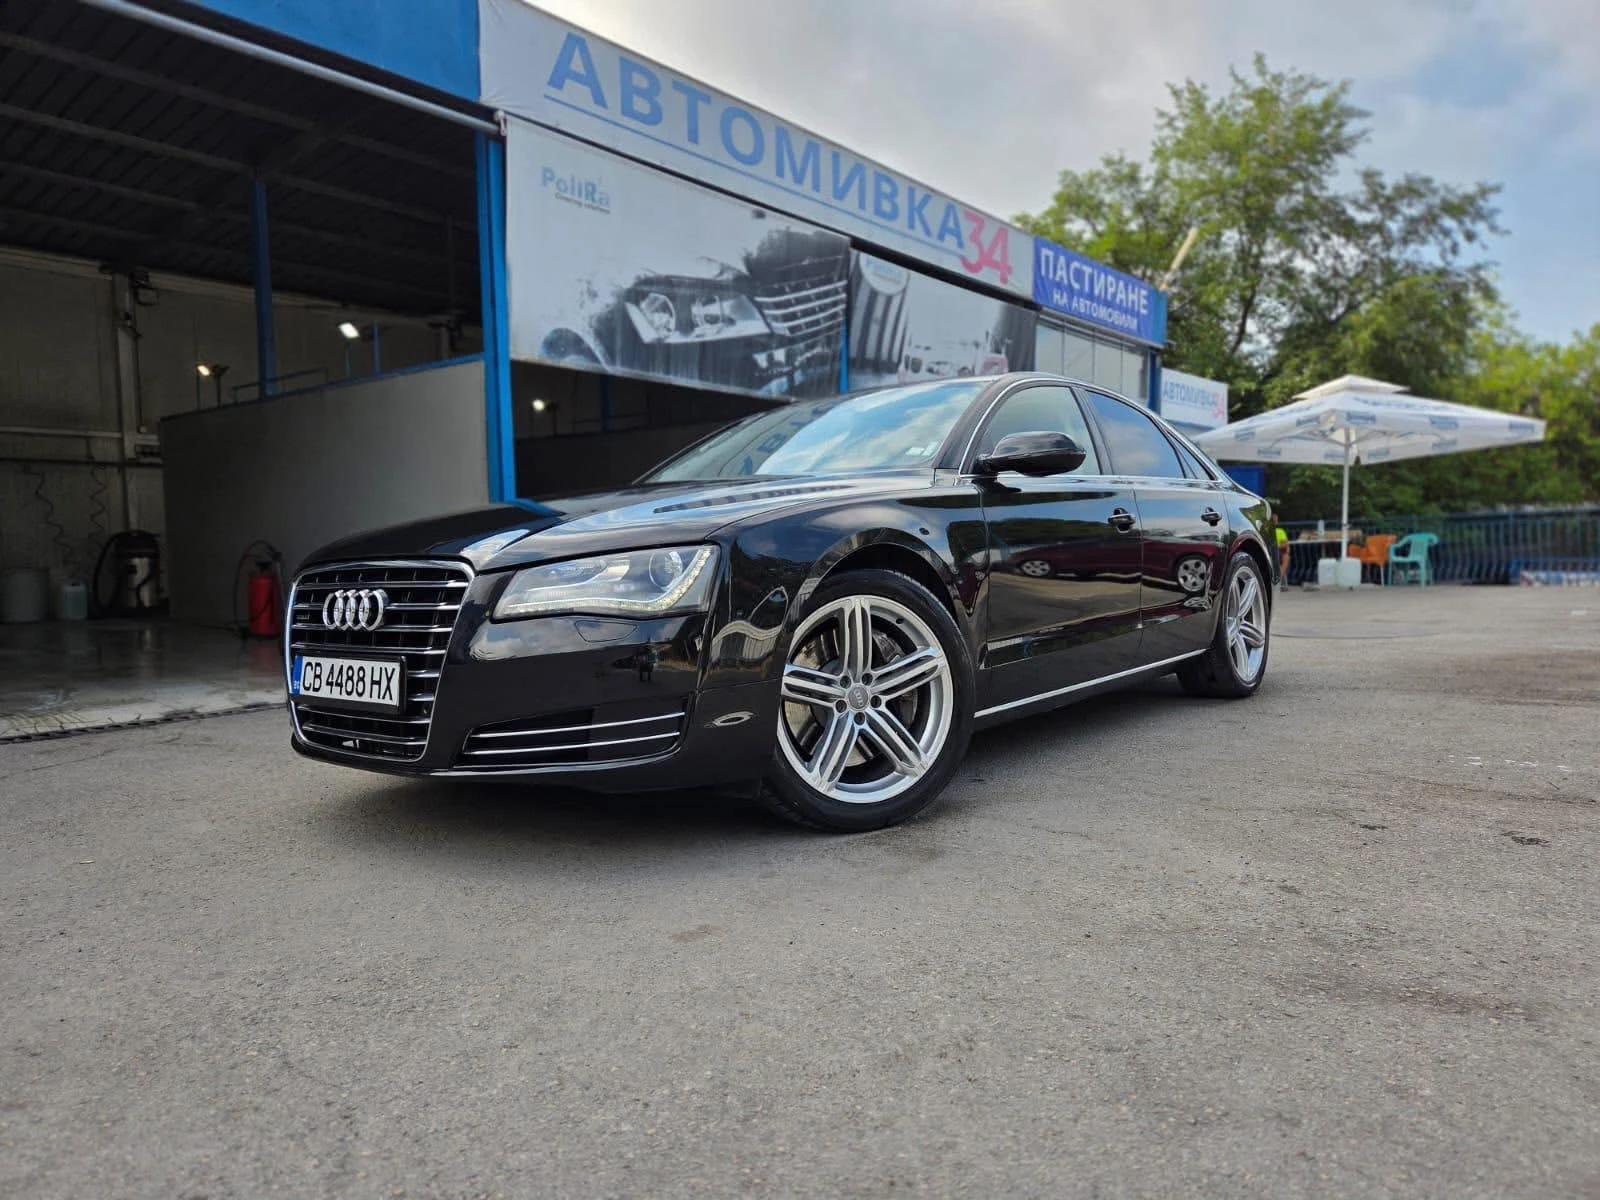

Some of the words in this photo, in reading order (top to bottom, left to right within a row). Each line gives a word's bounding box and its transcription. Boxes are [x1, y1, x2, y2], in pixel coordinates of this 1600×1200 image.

[547, 32, 964, 249] АВТОМИВКА
[960, 209, 1014, 285] 34
[1040, 247, 1149, 316] ПАСТИРАНЕ
[1053, 288, 1069, 309] НА
[303, 661, 323, 692] CB
[326, 663, 366, 698] 4488
[370, 666, 396, 701] HX
